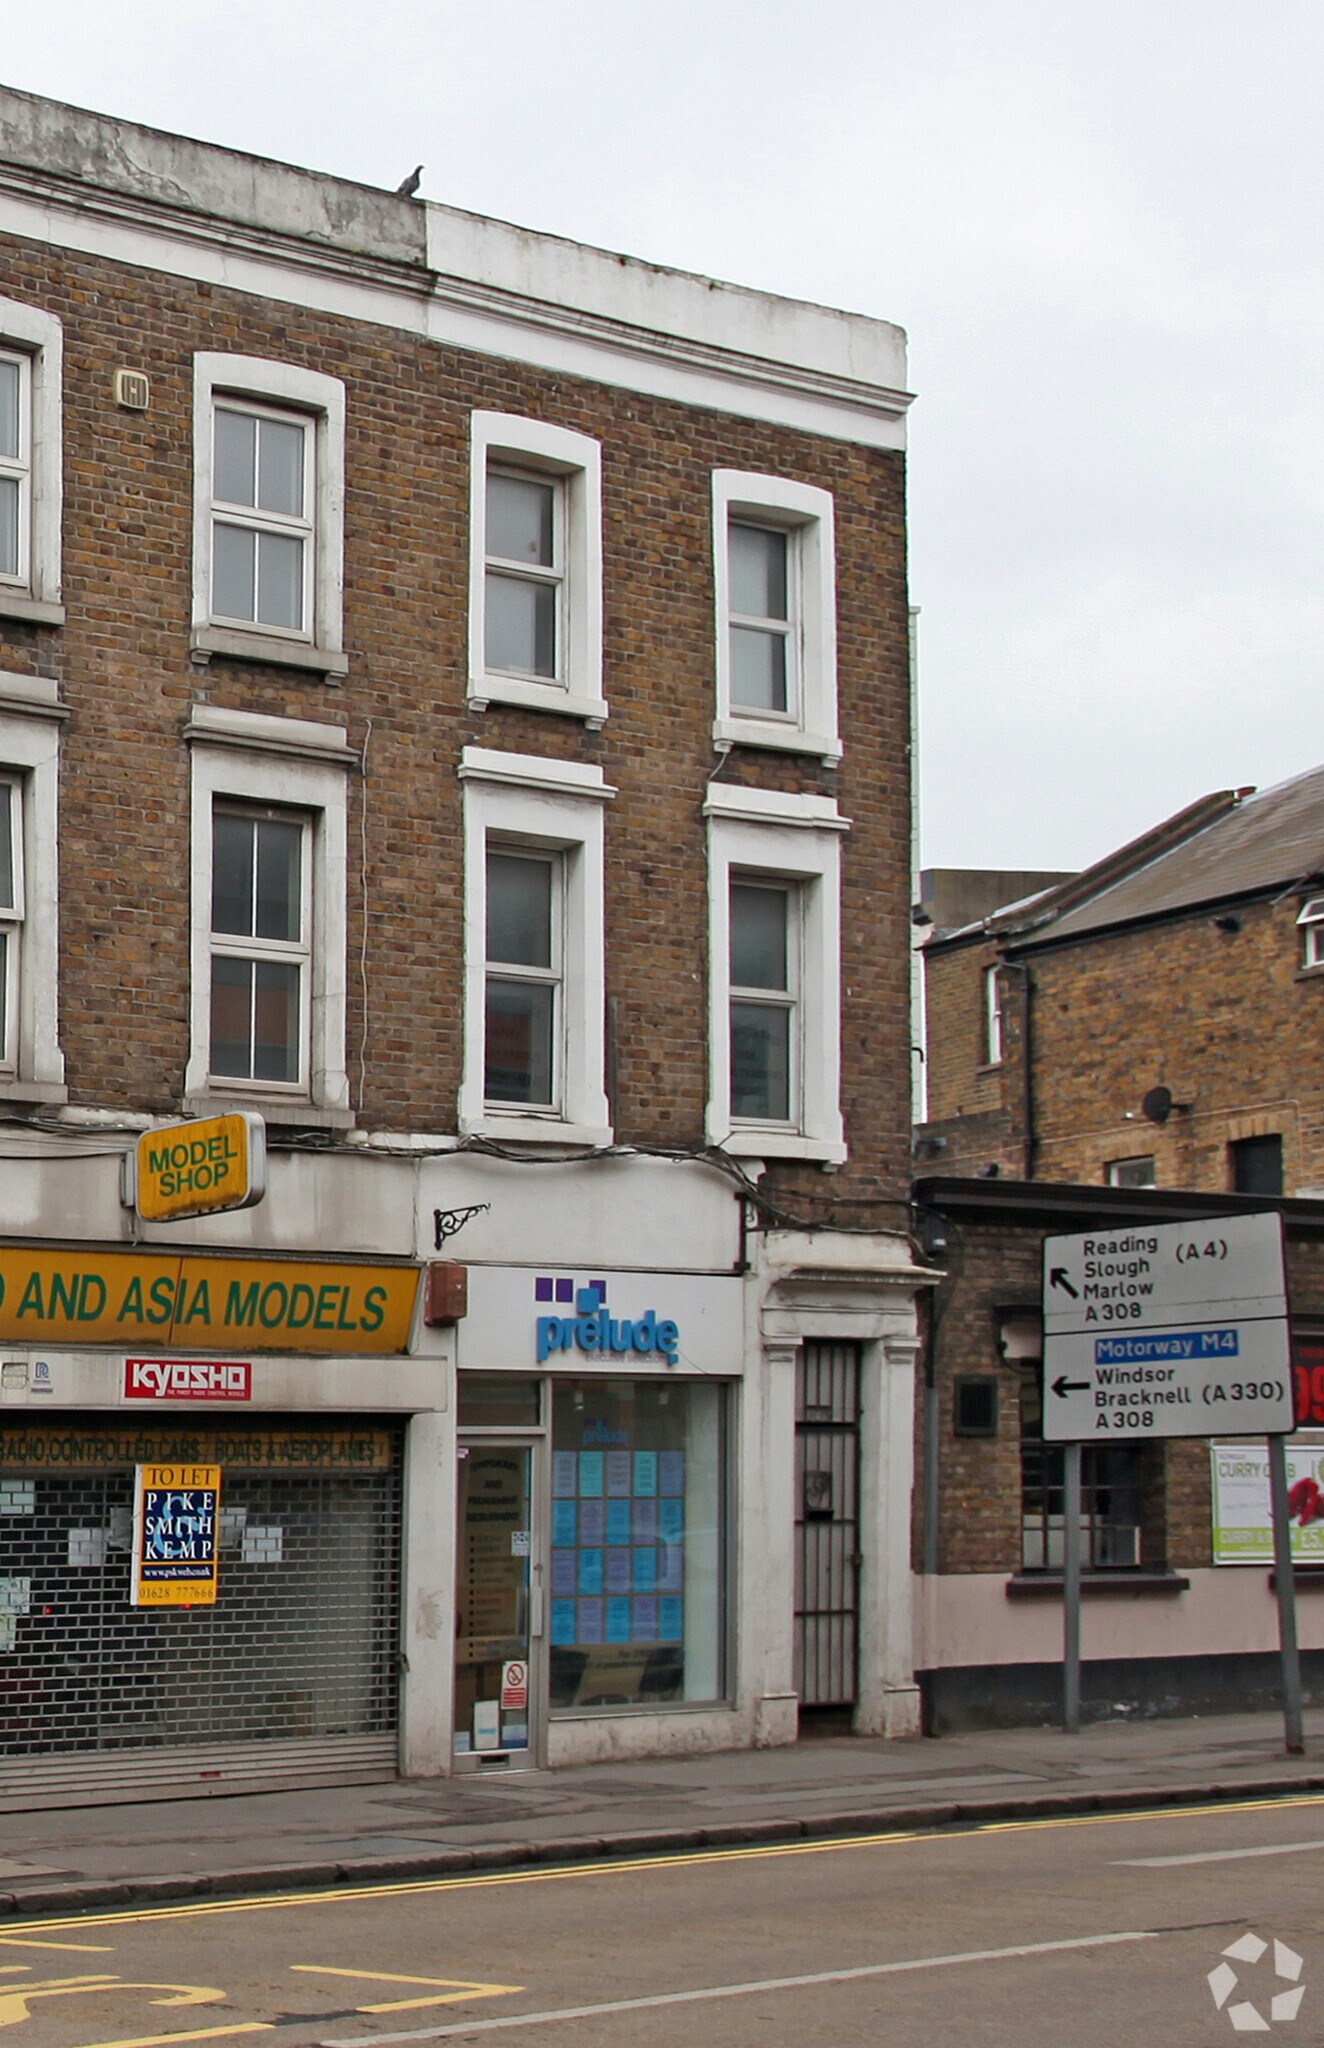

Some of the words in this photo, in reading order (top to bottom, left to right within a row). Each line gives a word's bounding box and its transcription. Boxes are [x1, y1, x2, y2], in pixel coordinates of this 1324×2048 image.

[149, 1134, 238, 1174] MODEL
[160, 1162, 229, 1197] SHOP
[1083, 1236, 1158, 1257] Reading
[1175, 1239, 1228, 1264] (A4)
[1084, 1257, 1150, 1279] Slough
[1083, 1281, 1154, 1300] Marlow
[16, 1271, 107, 1321] AND
[117, 1276, 211, 1325] ASIA
[224, 1280, 388, 1332] MODELS
[1085, 1302, 1142, 1322] A308
[536, 1308, 679, 1363] prelude
[1096, 1338, 1194, 1359] Motorway
[1202, 1332, 1235, 1351] M4
[1096, 1367, 1175, 1385] Windsor
[1095, 1386, 1191, 1407] Bracknell
[1203, 1380, 1284, 1405] (A330)
[1096, 1410, 1155, 1430] A308
[50, 1437, 153, 1462] CONTROLLED
[148, 1468, 175, 1486] TO
[181, 1468, 214, 1486] LET
[1218, 1462, 1261, 1478] CURRY
[1263, 1462, 1296, 1478] CB
[146, 1492, 213, 1511] PIKE
[146, 1516, 213, 1535] SMITH
[145, 1540, 212, 1560] KEMP
[140, 1587, 170, 1599] 01628
[176, 1586, 214, 1599] 777666
